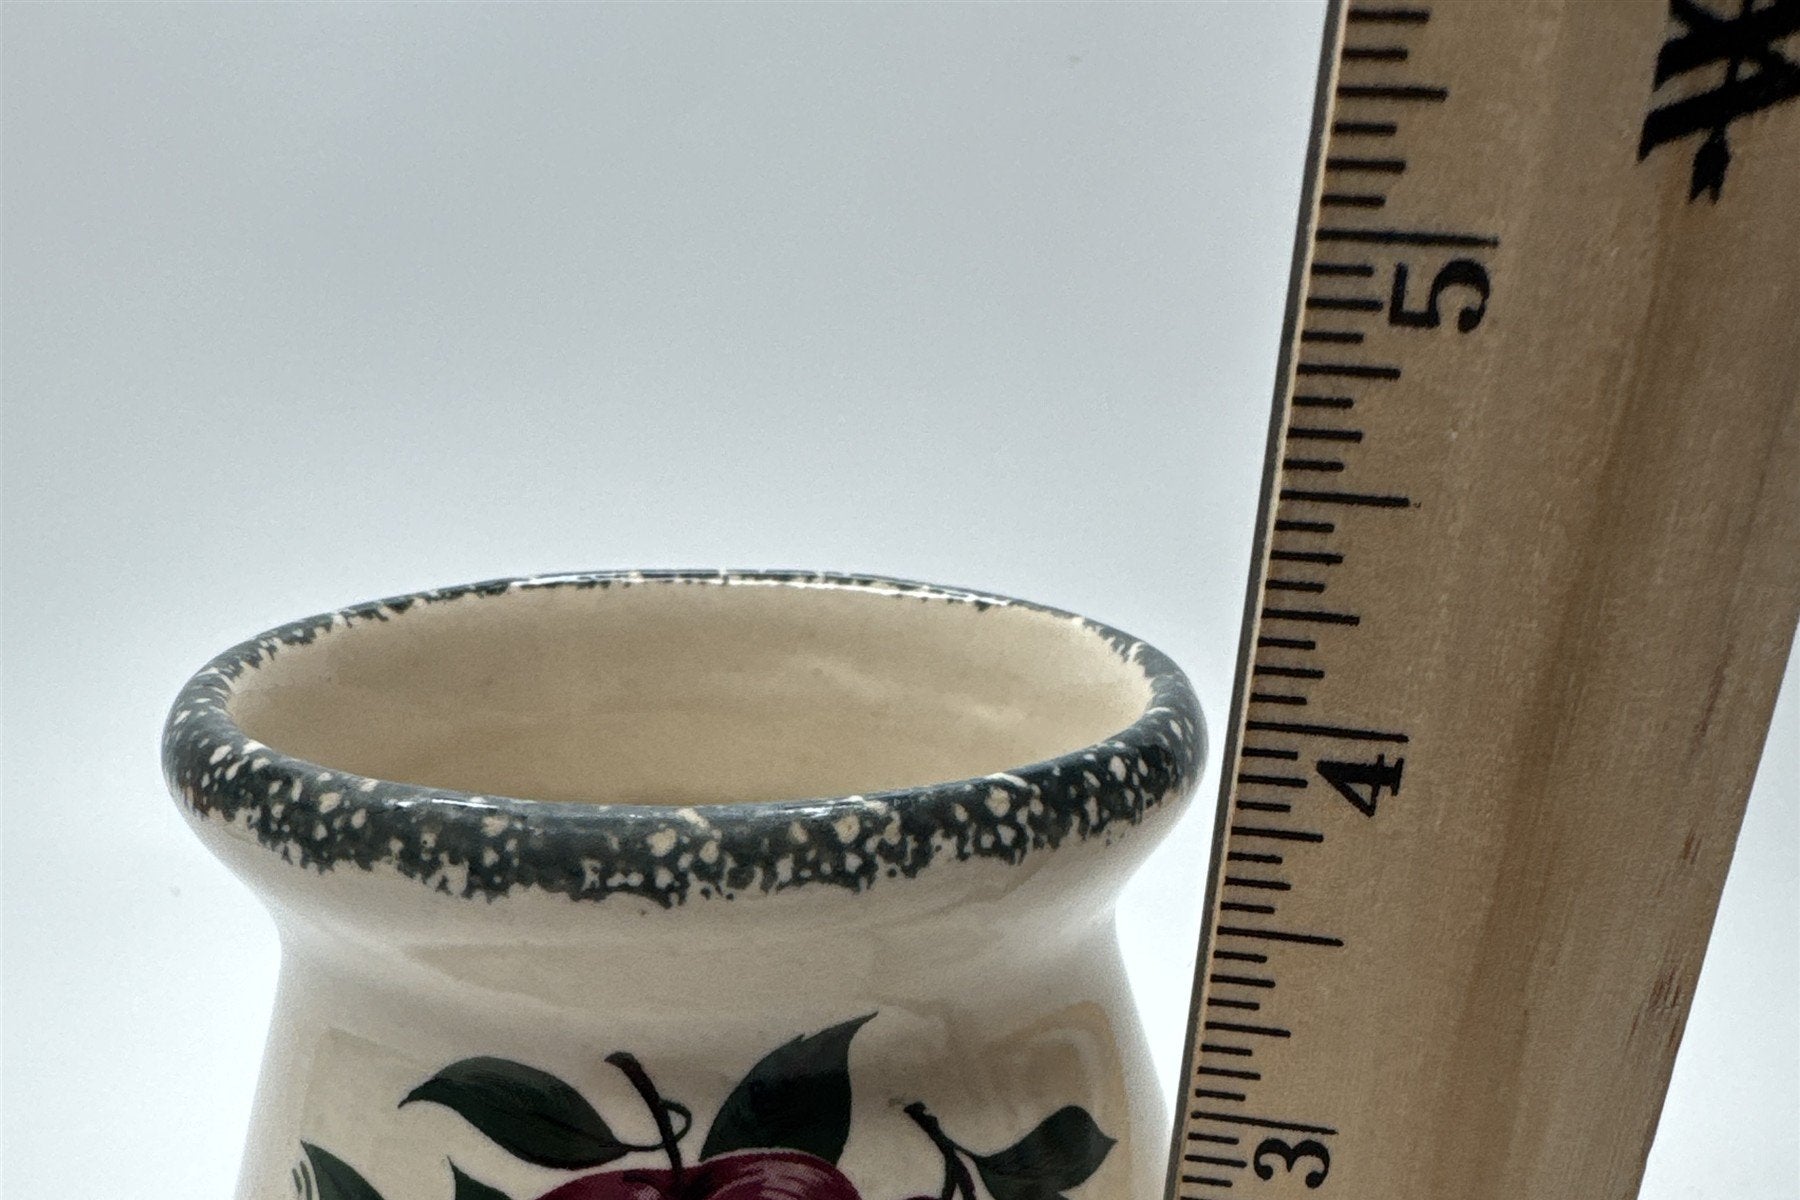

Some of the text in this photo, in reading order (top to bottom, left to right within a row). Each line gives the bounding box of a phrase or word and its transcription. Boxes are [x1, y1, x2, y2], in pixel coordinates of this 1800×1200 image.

[1388, 258, 1491, 334] 5
[1316, 753, 1405, 817] 4
[1252, 1138, 1331, 1189] 3
